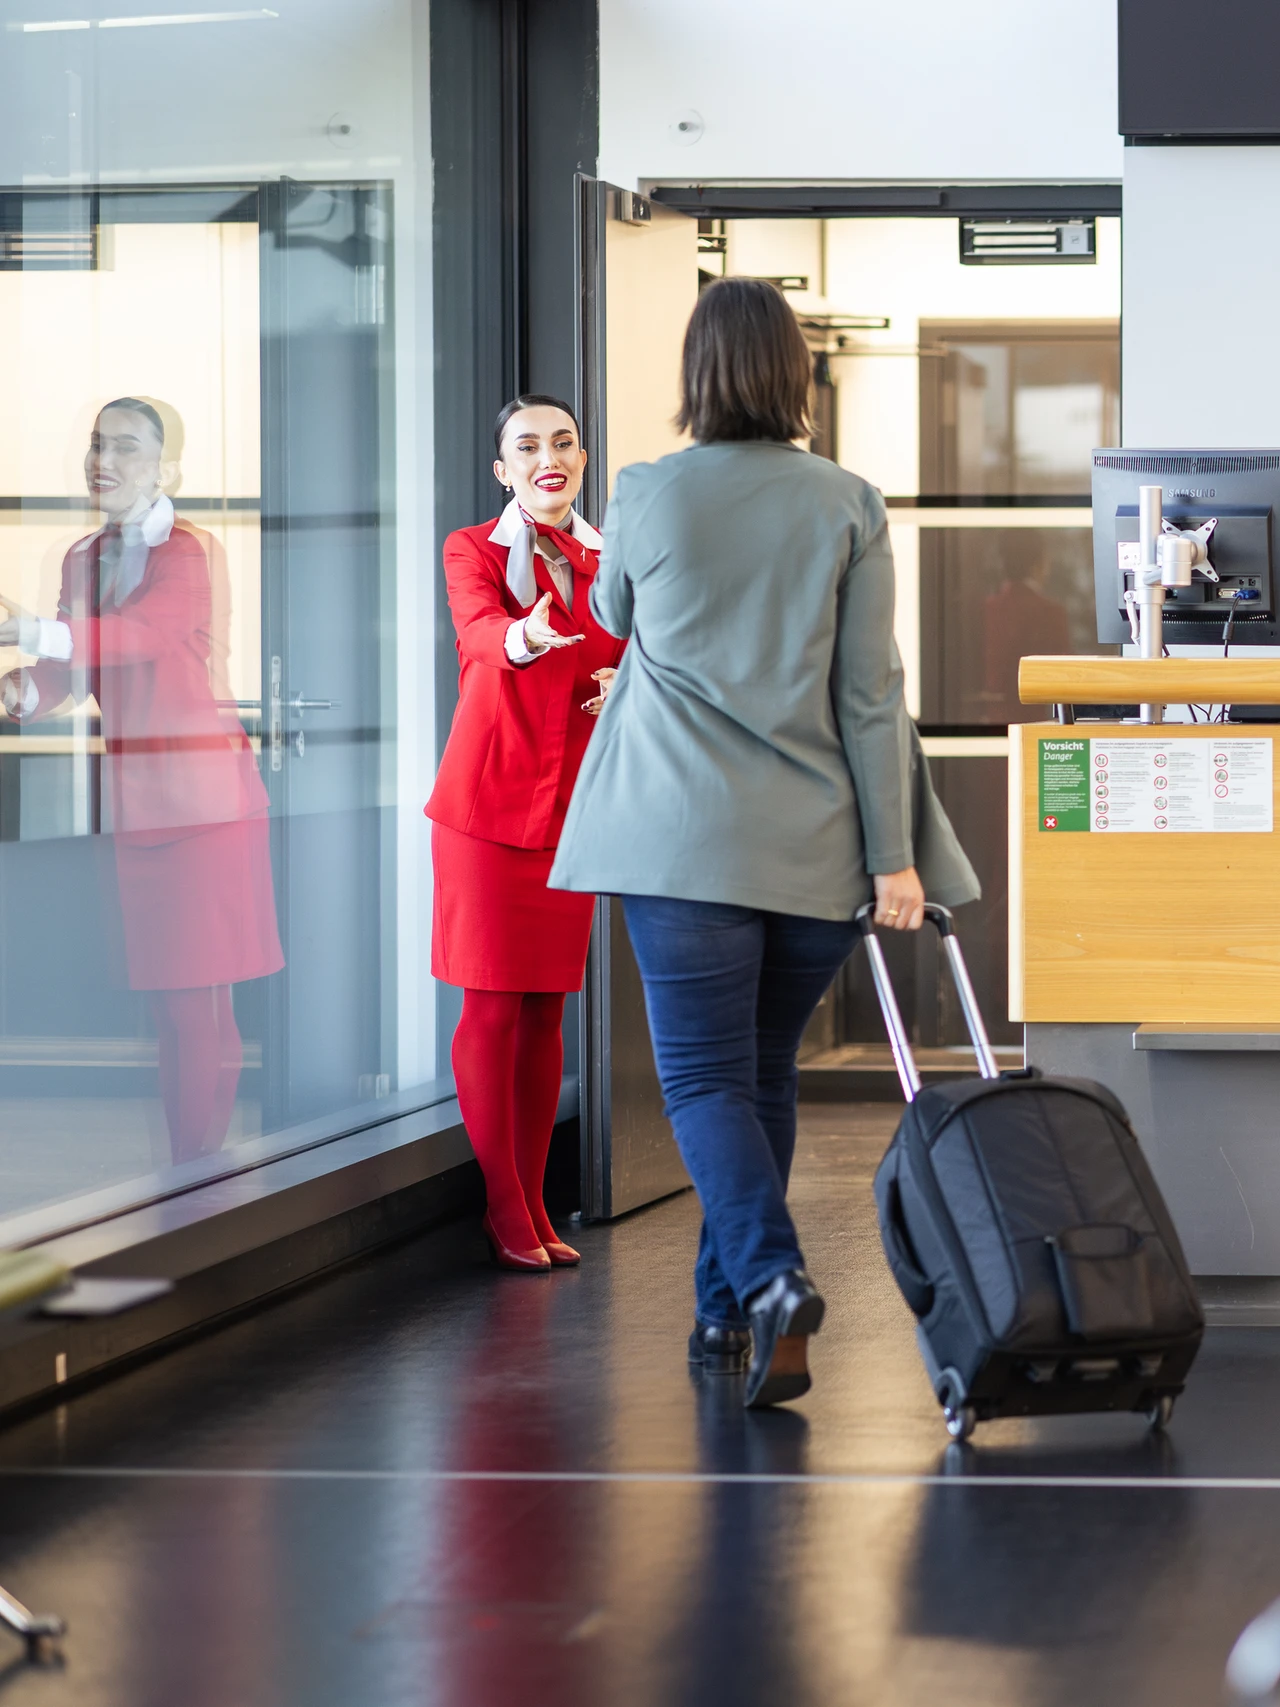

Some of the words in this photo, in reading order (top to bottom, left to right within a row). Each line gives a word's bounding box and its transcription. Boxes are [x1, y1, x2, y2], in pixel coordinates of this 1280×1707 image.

[1168, 488, 1216, 498] SAMSUNG
[1043, 741, 1084, 750] Vorsicht
[1043, 752, 1073, 762] Danger
